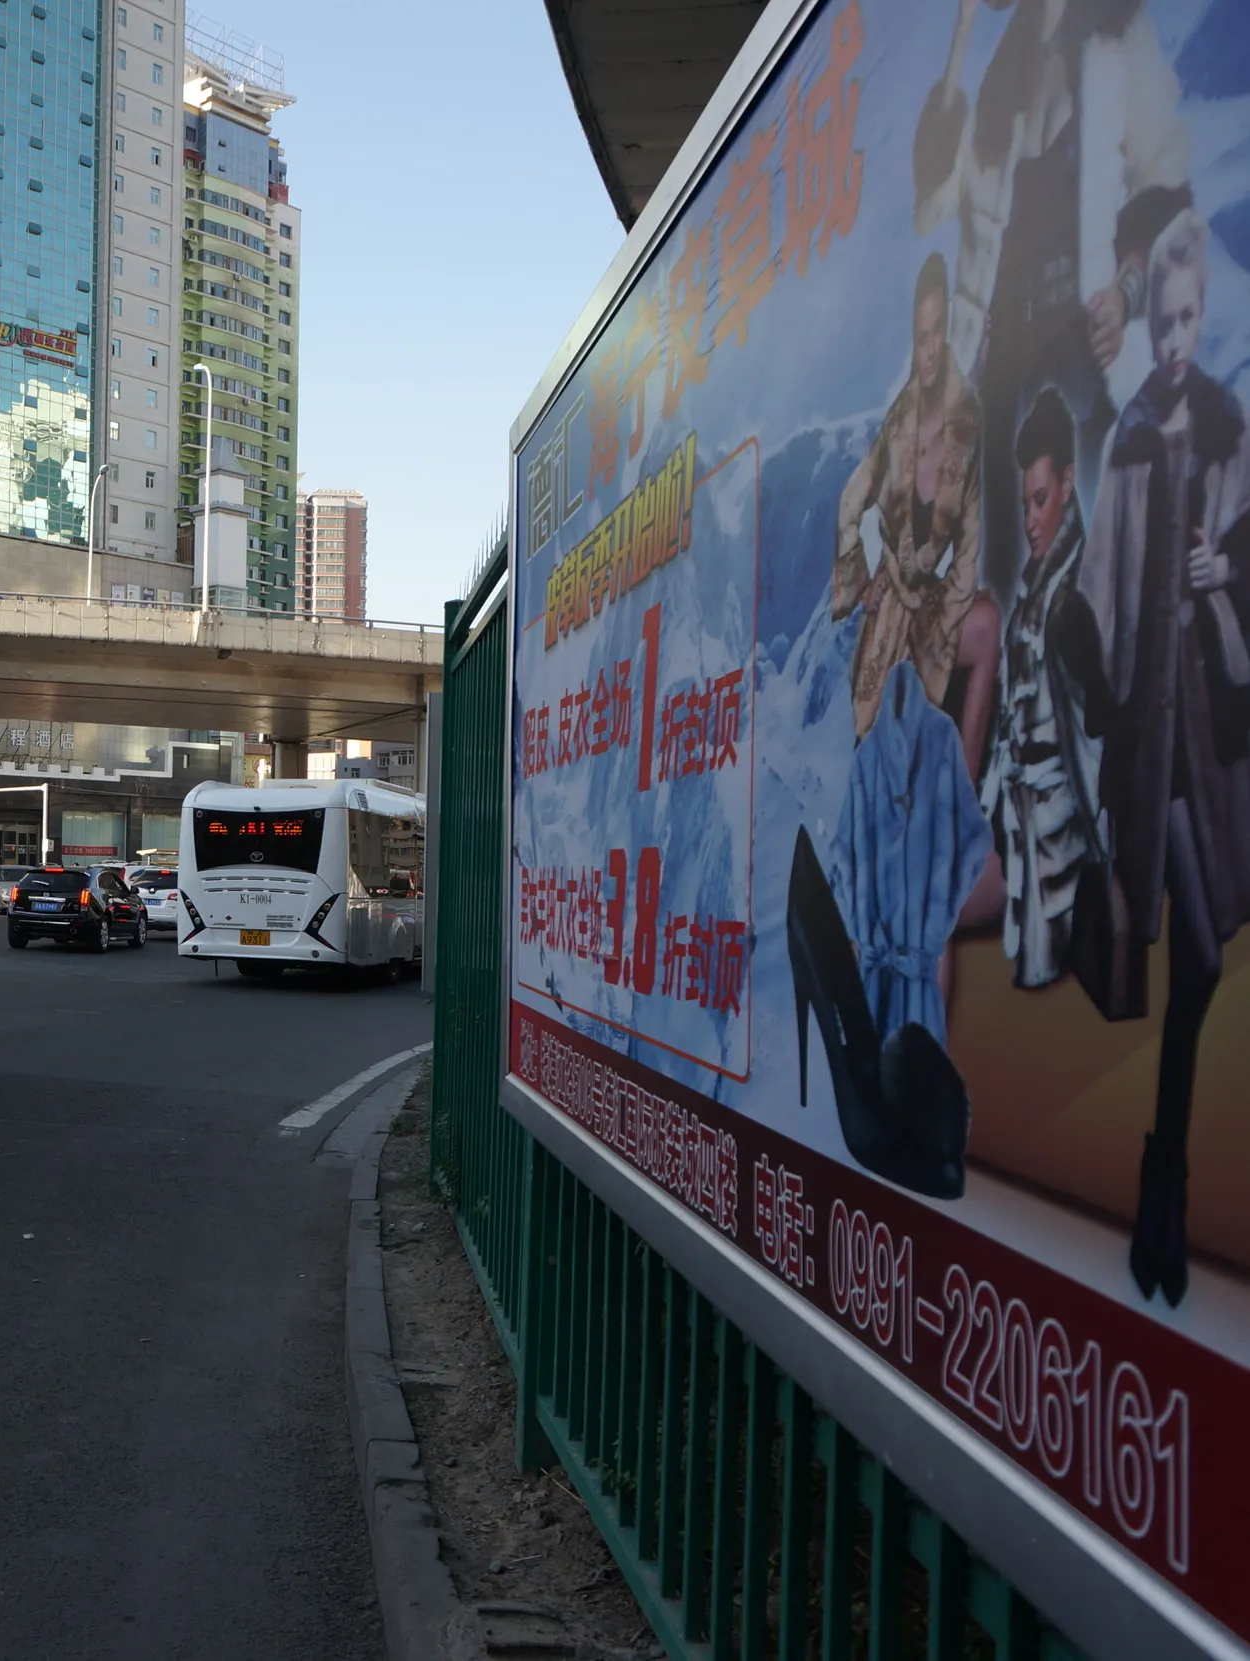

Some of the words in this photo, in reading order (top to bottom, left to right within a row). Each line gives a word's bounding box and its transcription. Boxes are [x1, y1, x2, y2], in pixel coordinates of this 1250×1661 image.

[240, 893, 272, 904] K1-0004
[754, 1153, 815, 1288] 电话：
[828, 1198, 1190, 1574] 0991-2206161
